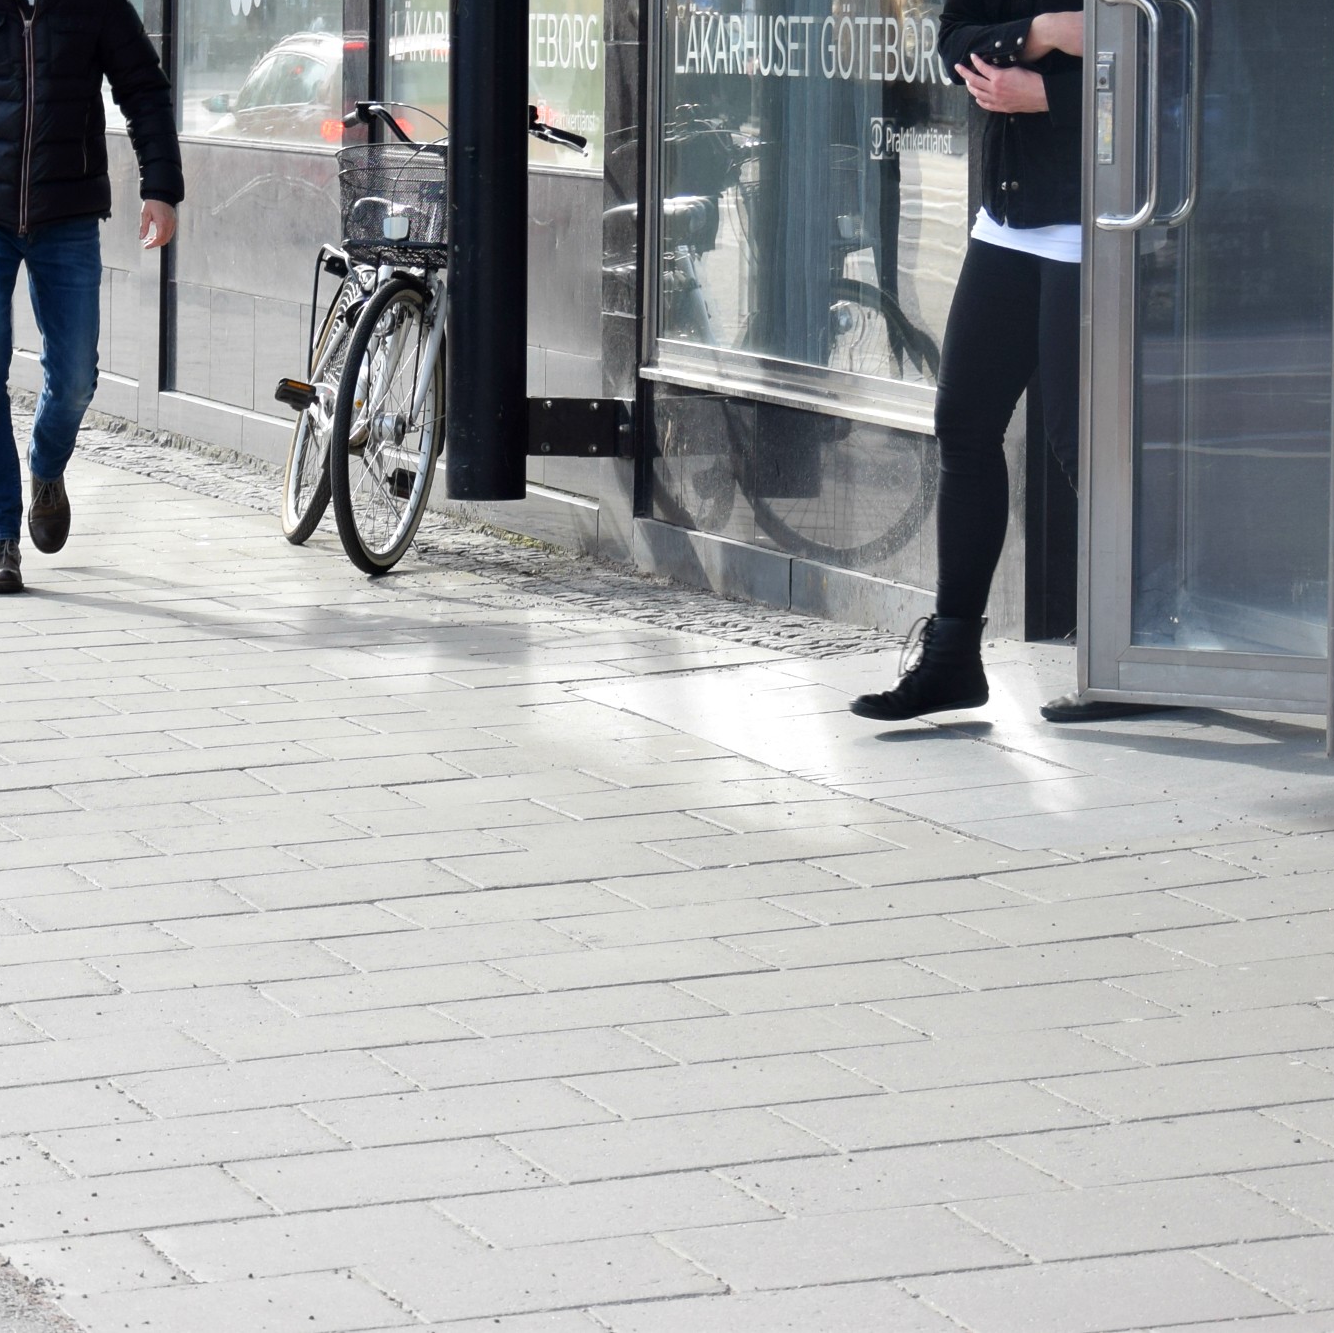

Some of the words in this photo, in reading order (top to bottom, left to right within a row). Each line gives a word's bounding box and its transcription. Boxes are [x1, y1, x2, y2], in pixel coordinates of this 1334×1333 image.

[394, 0, 450, 63] LÄKAR
[528, 12, 599, 71] TEBORG
[674, 3, 814, 76] LÄKARHUSET
[885, 126, 953, 156] Praktikertjänst
